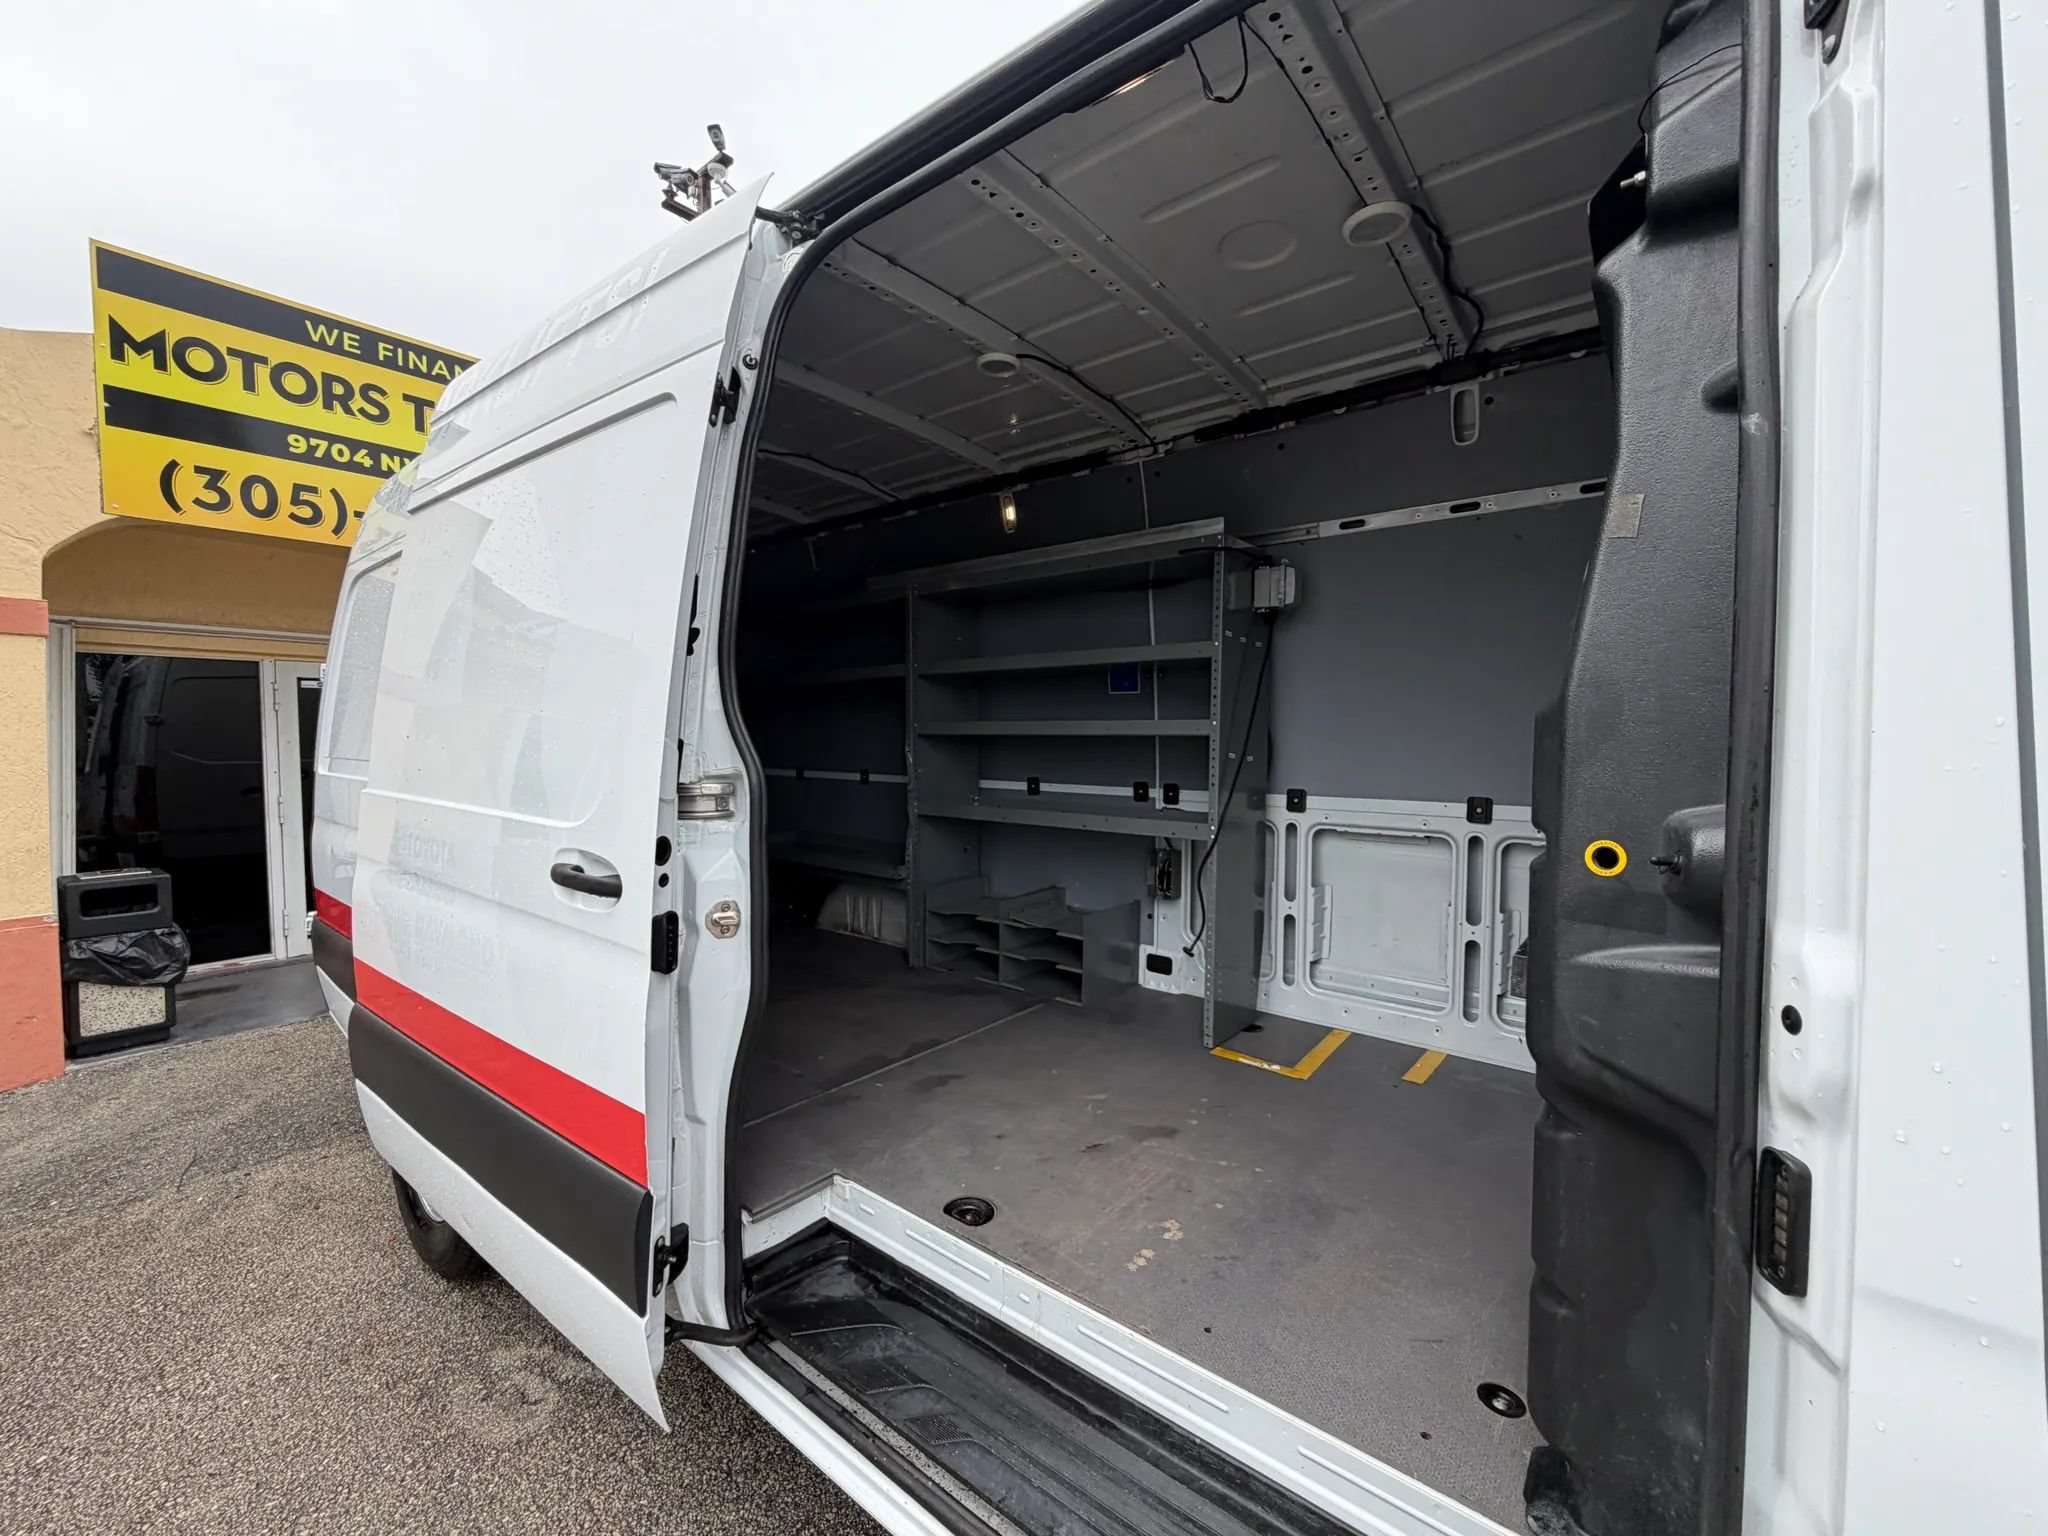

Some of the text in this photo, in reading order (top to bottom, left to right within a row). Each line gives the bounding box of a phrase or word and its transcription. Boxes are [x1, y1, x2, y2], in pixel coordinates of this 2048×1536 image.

[304, 319, 362, 355] WE
[107, 313, 436, 436] MOTORS T
[286, 433, 413, 474] 9704 N
